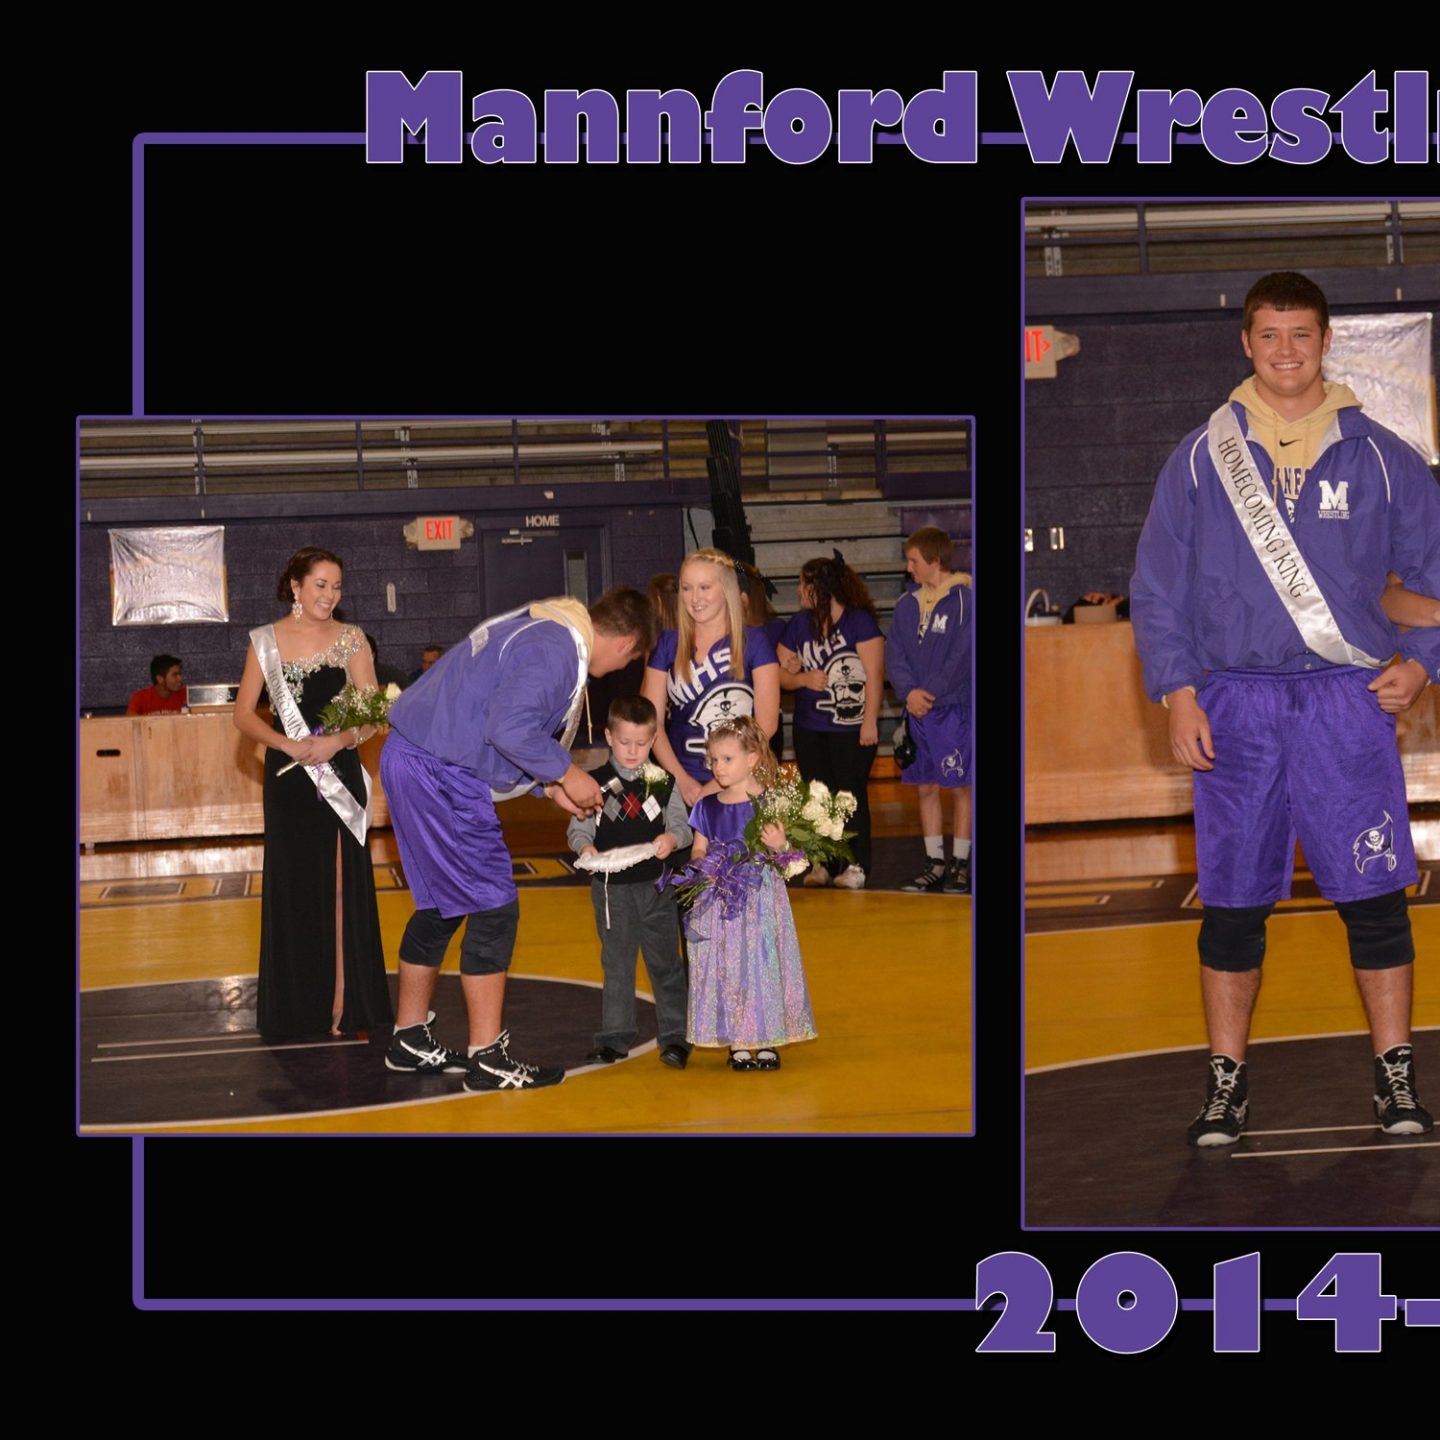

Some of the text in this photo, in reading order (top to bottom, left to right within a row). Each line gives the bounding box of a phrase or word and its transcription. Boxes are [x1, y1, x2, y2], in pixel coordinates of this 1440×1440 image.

[1318, 480, 1349, 510] M
[424, 517, 454, 541] EXIT
[525, 514, 560, 528] HOME
[1218, 436, 1285, 553] HOMECOMING
[1273, 551, 1309, 599] KING
[666, 647, 733, 710] MHS
